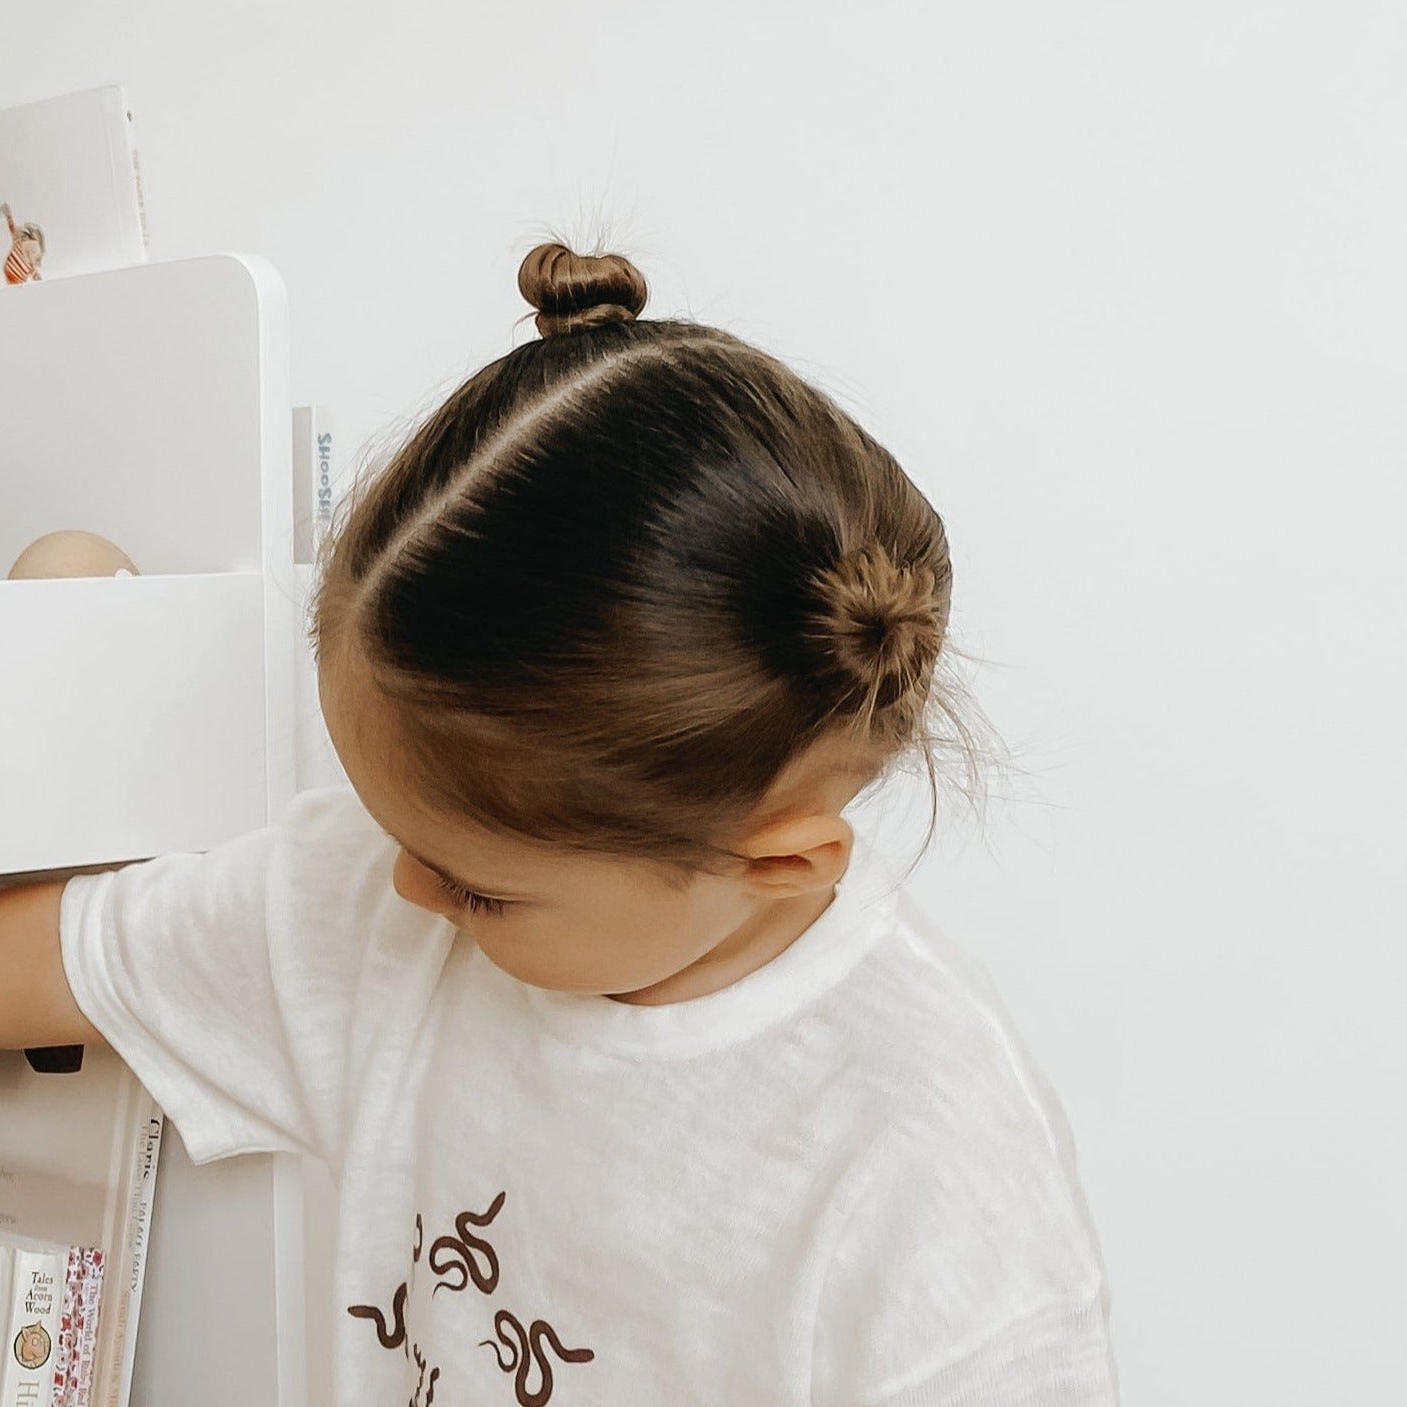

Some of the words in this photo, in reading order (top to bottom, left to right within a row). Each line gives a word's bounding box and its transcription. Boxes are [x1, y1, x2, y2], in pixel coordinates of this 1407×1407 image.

[143, 1118, 160, 1180] Claris
[31, 1271, 53, 1285] Tales
[26, 1289, 53, 1301] Acorn
[88, 1283, 99, 1305] The
[25, 1301, 52, 1315] Wood
[84, 1307, 96, 1340] World
